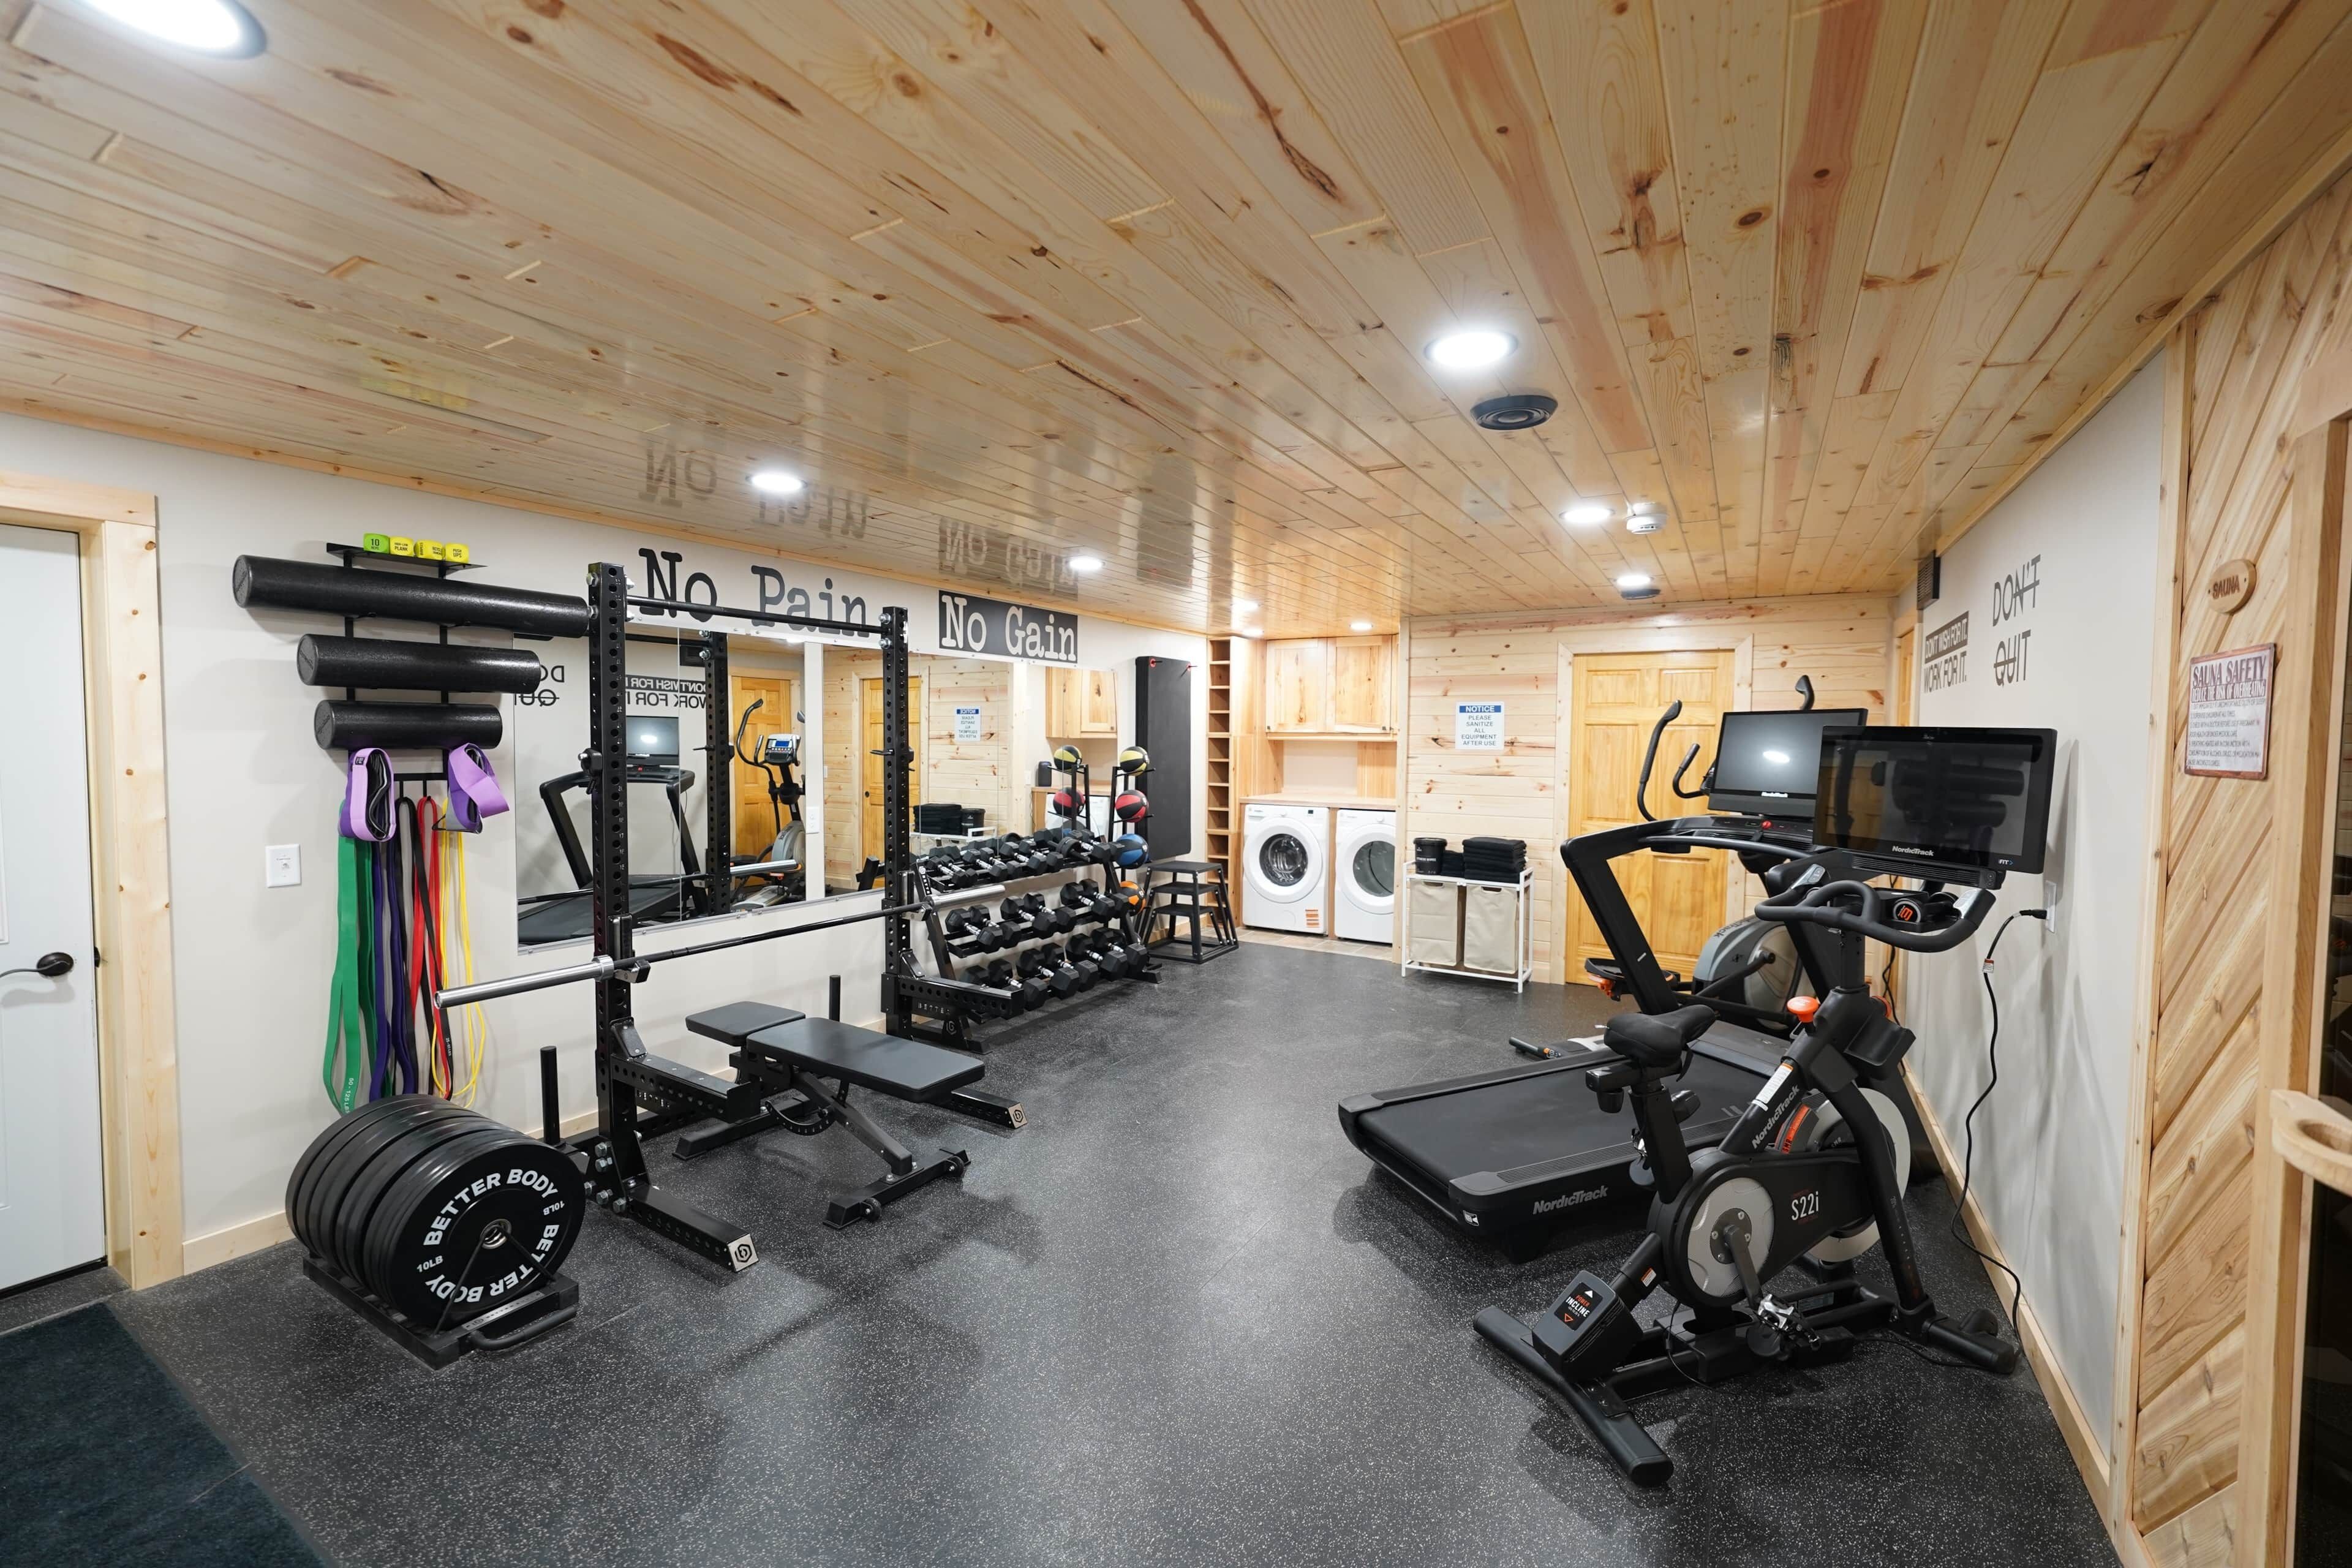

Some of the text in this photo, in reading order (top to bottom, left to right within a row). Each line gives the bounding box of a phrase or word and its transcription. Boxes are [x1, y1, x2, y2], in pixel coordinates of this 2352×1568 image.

[639, 548, 870, 638] No Pain
[1992, 554, 2041, 626] DON'T
[2212, 575, 2240, 600] SAUNA
[941, 595, 1076, 662] No Gain
[1994, 629, 2031, 688] QUIT
[2193, 655, 2266, 687] SAUNA SAFETY
[1924, 660, 1942, 693] WORK
[1943, 655, 1958, 688] FOR
[2216, 684, 2226, 700] RISK
[2226, 684, 2233, 699] OF
[2234, 680, 2265, 698] OVERHEATING
[1892, 846, 1934, 856] NordicTrack
[1752, 1085, 1800, 1149] NordicTrack
[1783, 1138, 1792, 1152] SMR
[423, 1169, 559, 1246] BETTER BODY
[543, 1200, 565, 1215] 10LB
[1533, 1186, 1608, 1215] NordicTrack
[1791, 1191, 1819, 1220] S22i
[416, 1256, 443, 1273] 10LB
[1566, 1296, 1590, 1317] INCLINE
[1575, 1294, 1590, 1307] POWER
